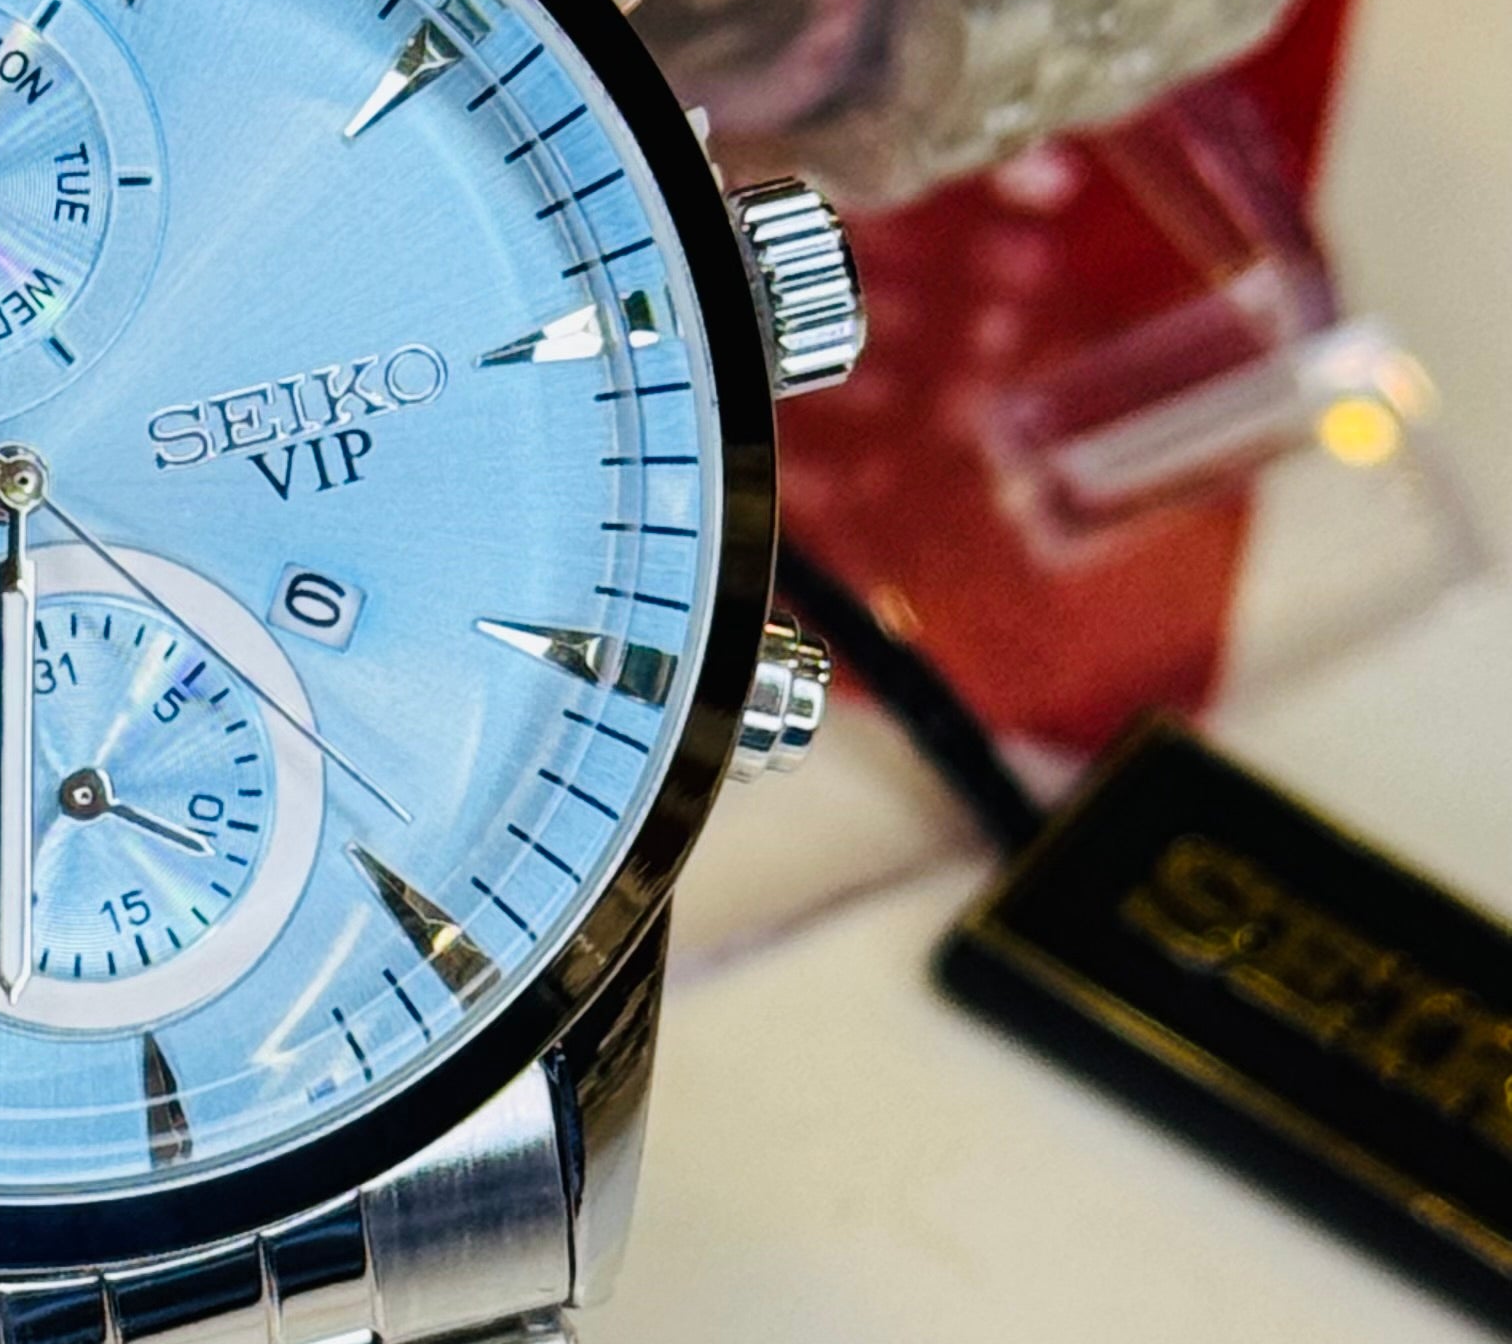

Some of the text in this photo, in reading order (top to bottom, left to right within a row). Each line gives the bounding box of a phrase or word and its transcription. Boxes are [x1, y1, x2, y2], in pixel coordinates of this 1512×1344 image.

[53, 141, 90, 227] TUE
[147, 344, 448, 470] SEIKO
[246, 428, 373, 501] VIP
[284, 572, 346, 628] 6
[33, 652, 78, 695] 31
[152, 686, 186, 724] 5
[99, 888, 152, 933] 15
